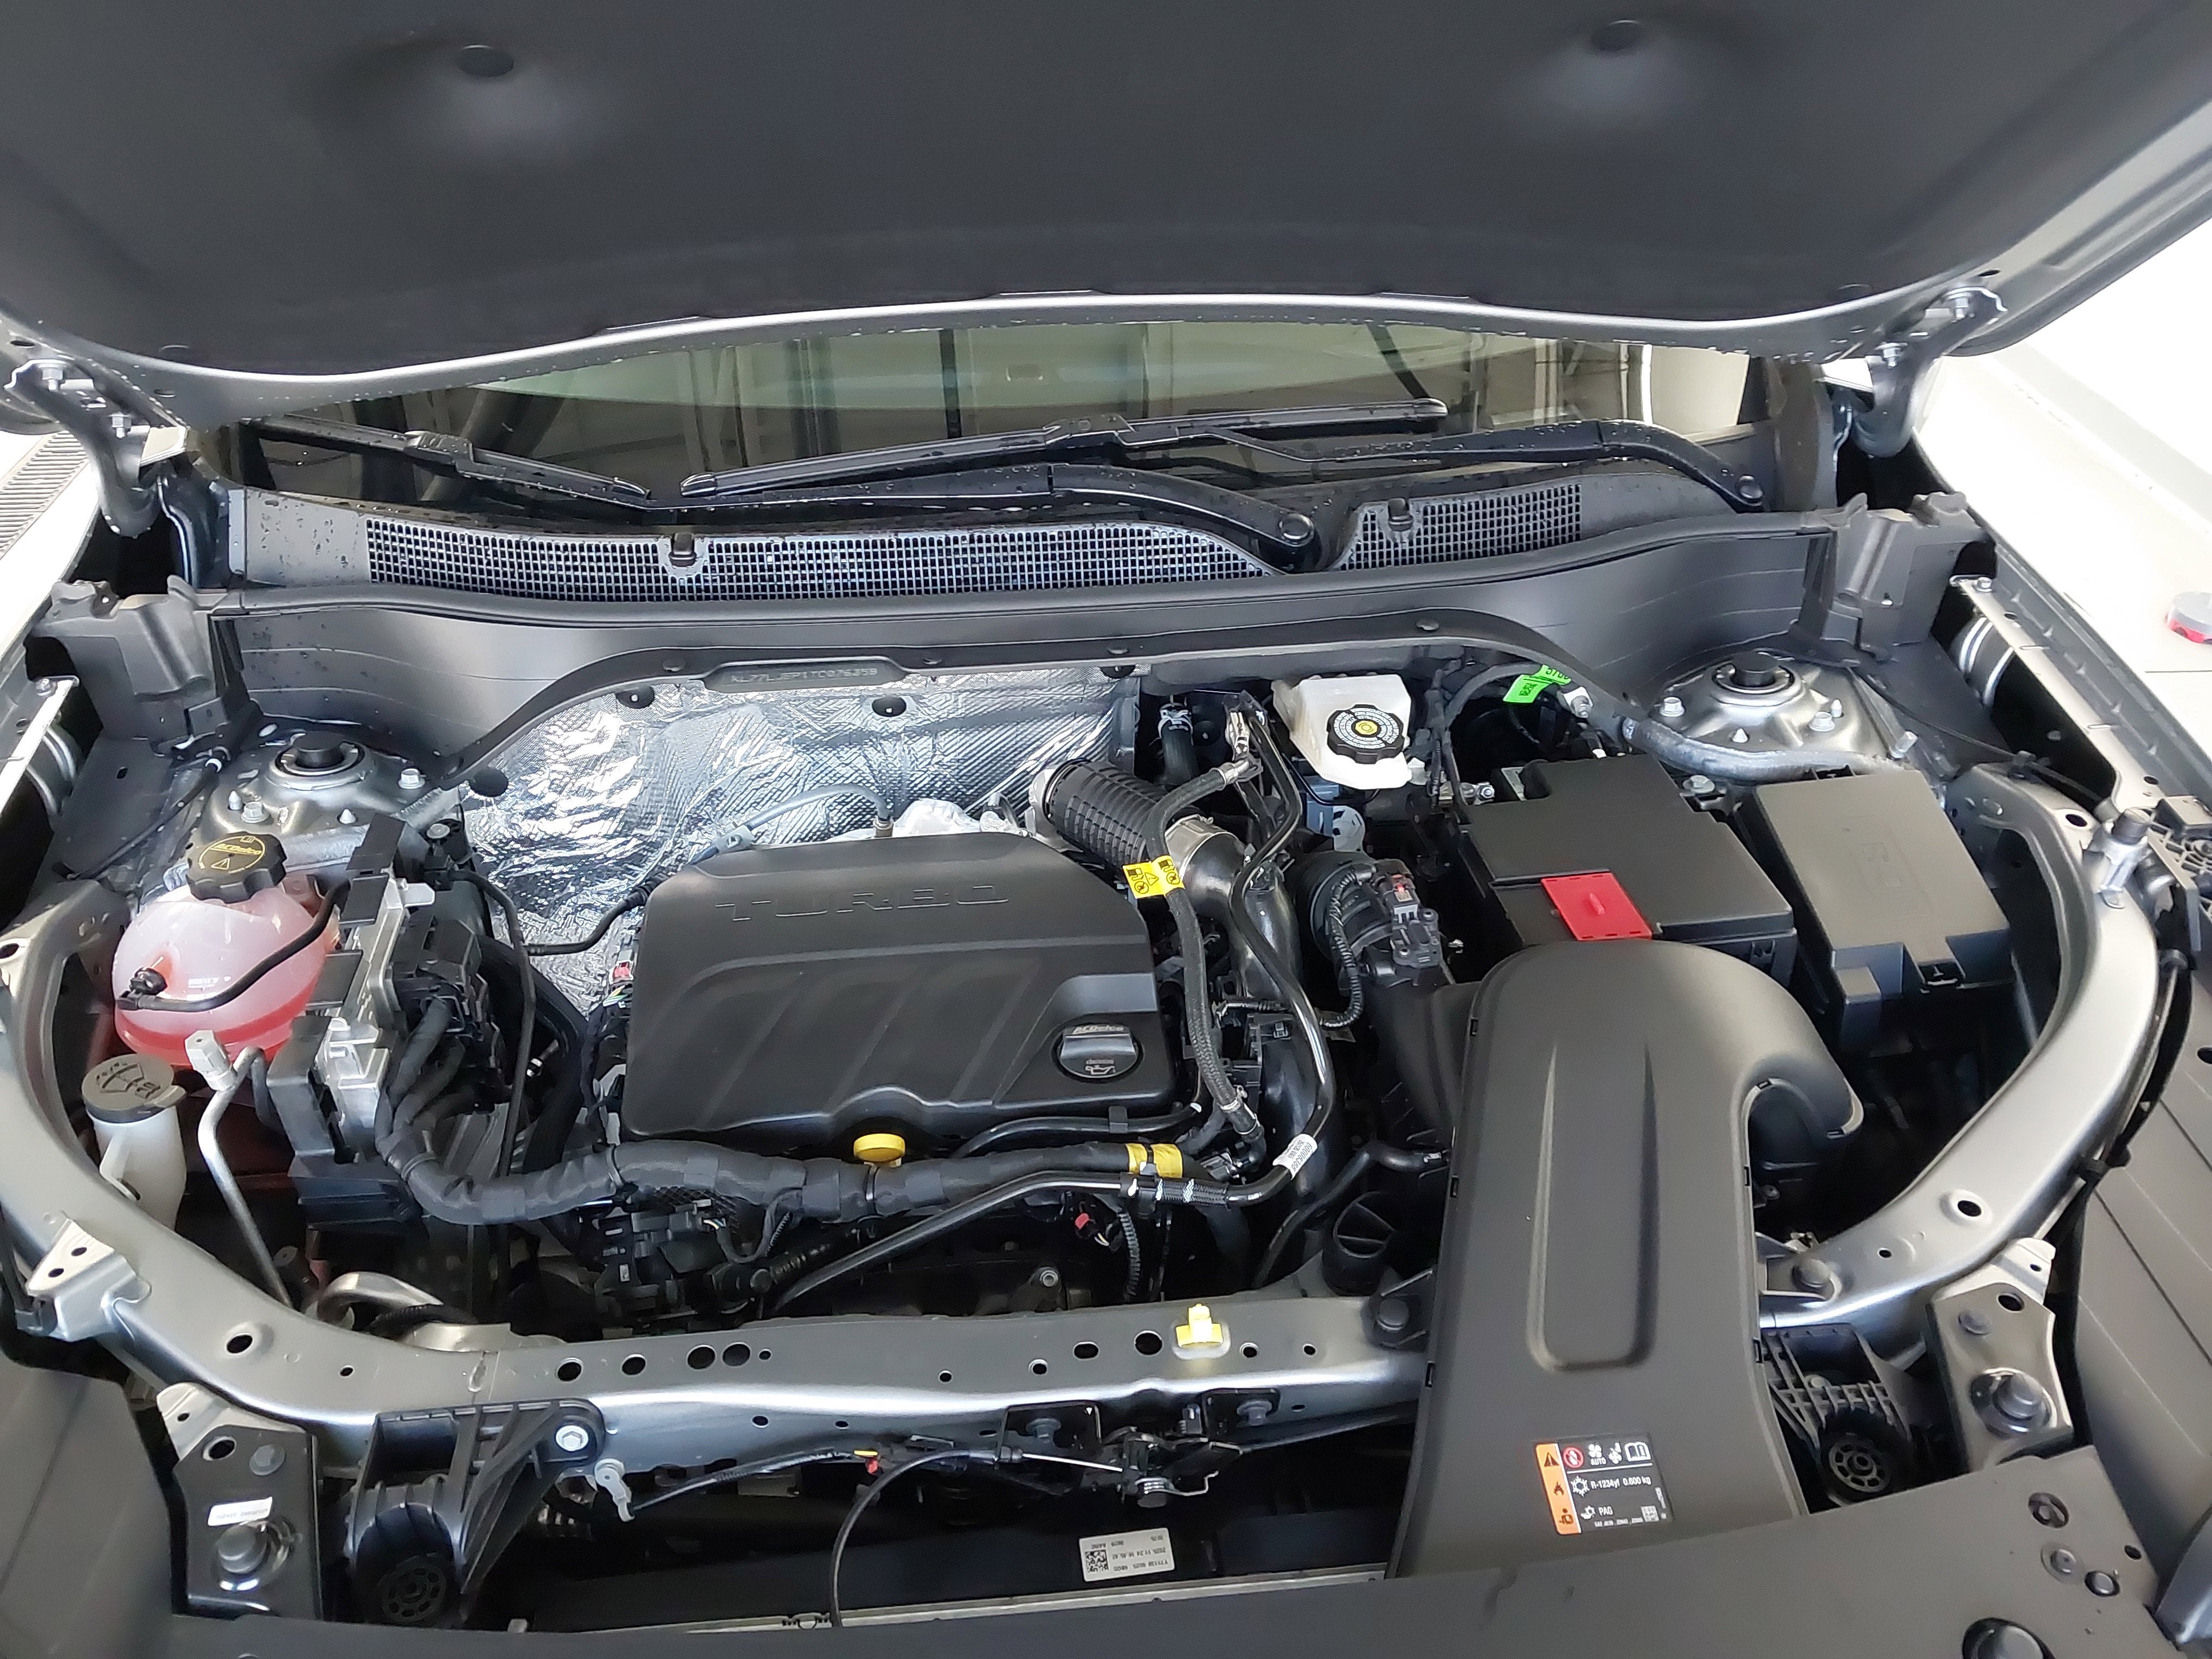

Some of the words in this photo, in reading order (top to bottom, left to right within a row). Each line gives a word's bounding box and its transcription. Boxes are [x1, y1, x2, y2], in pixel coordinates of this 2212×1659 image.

[211, 844, 262, 855] ACDelco
[715, 885, 1009, 921] TURBO
[1590, 1457, 1606, 1465] AUTO
[1641, 1476, 1651, 1486] kg
[1598, 1506, 1613, 1515] PAG
